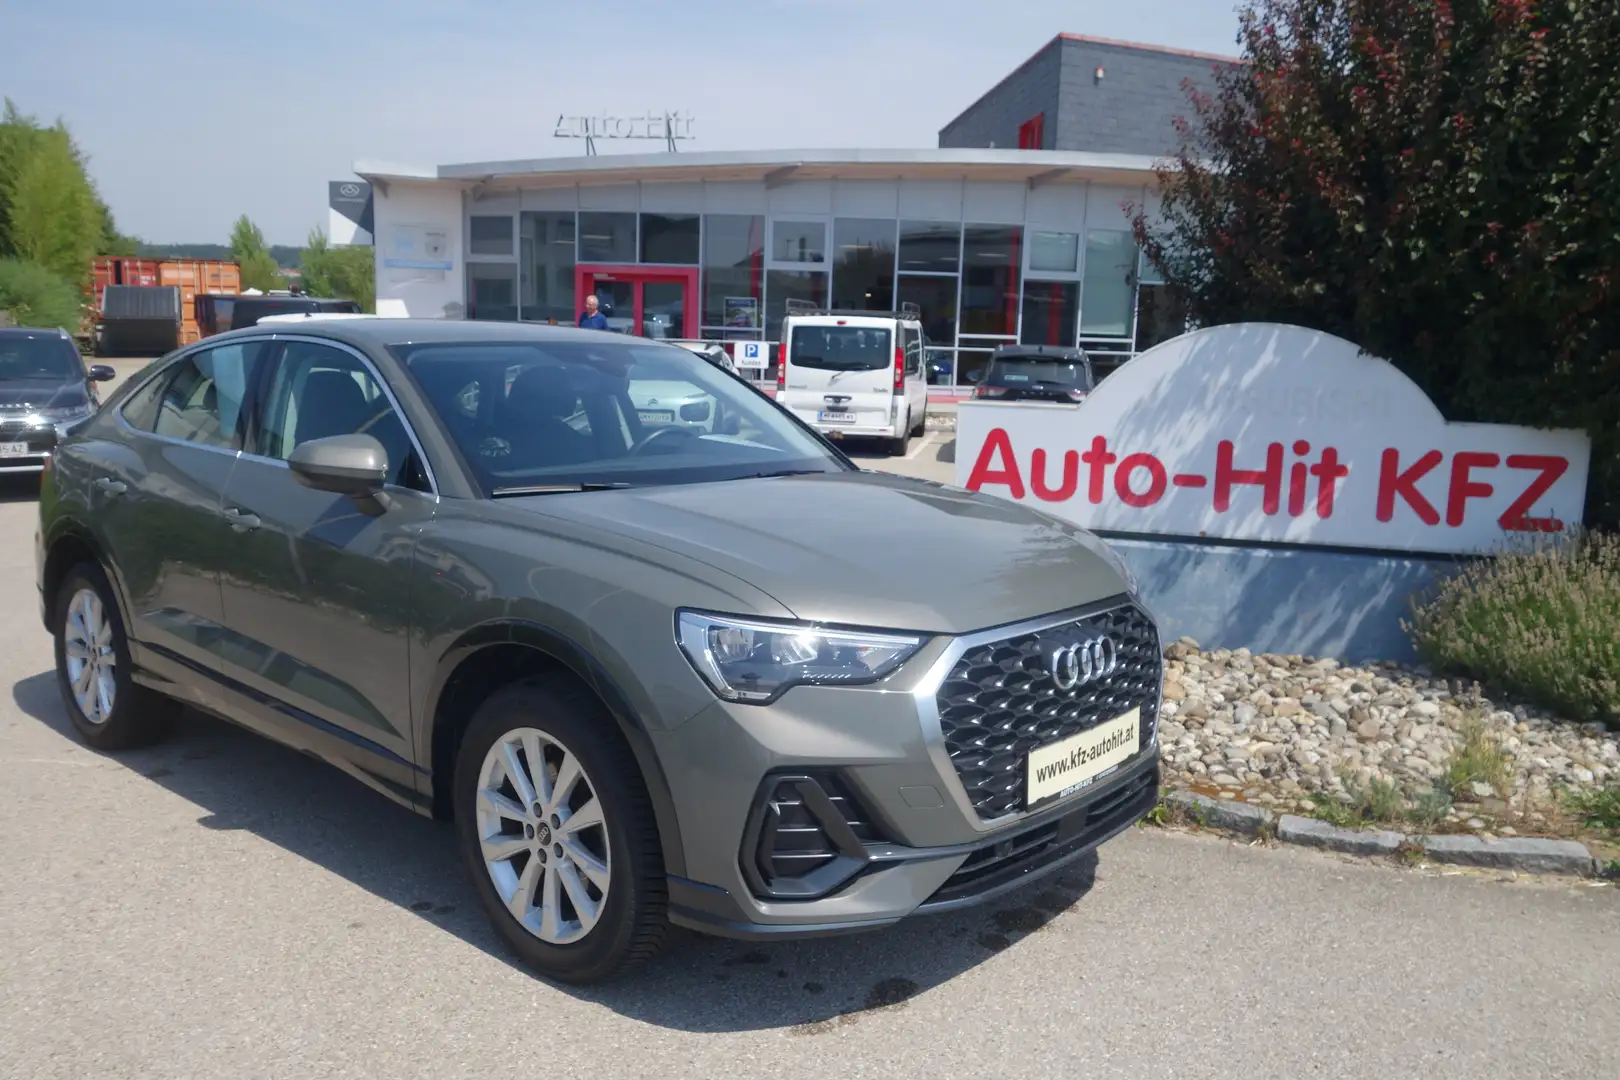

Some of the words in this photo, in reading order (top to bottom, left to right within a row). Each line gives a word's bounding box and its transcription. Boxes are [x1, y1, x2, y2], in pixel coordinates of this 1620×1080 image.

[965, 427, 1349, 519] Auto-Hit
[1376, 447, 1569, 532] KFZ
[1036, 722, 1134, 783] www.kfz-autohit.at
